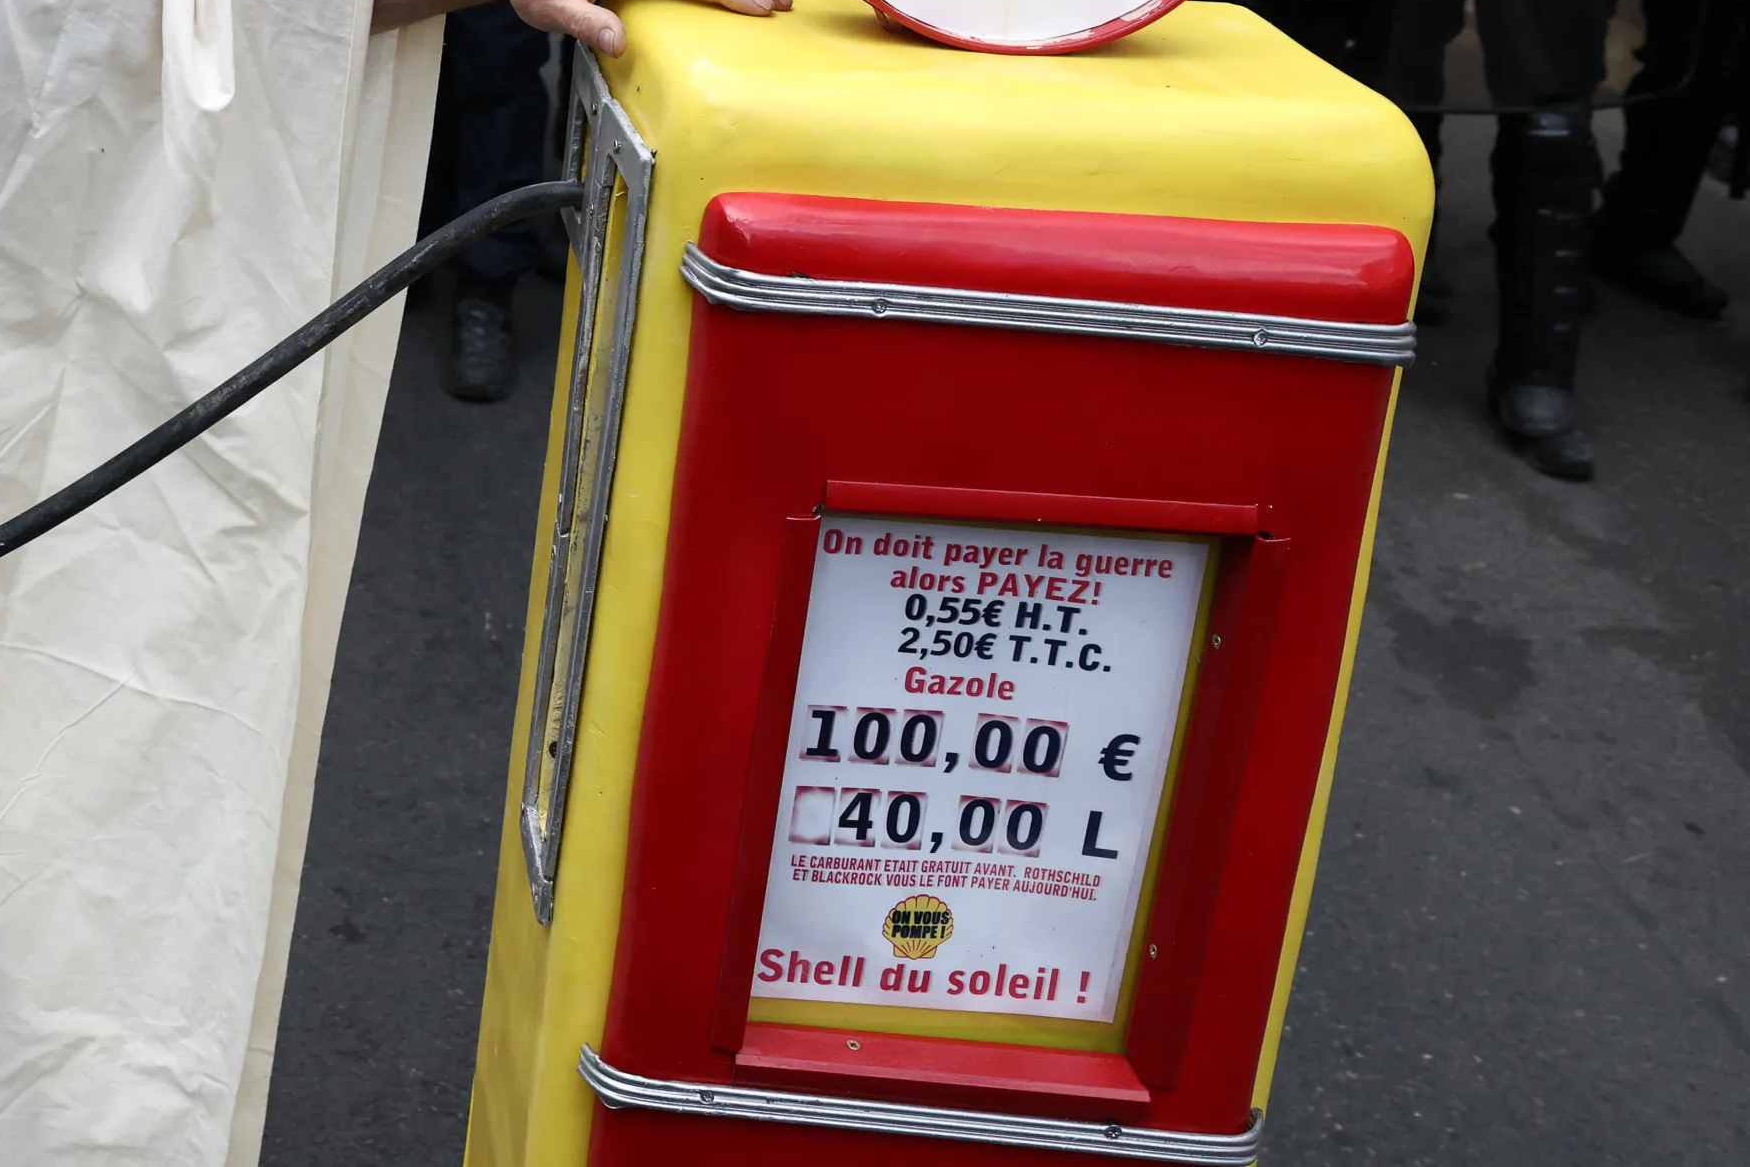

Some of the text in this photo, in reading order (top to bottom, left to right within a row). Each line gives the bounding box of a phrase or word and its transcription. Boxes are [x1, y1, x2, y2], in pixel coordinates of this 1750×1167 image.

[823, 529, 1174, 579] On doit payer la guerre
[890, 566, 1102, 605] alors PAYEZ!
[905, 594, 1088, 635] 0,55€ H.T.
[898, 627, 1111, 672] 2,50€ T.T.C.
[904, 666, 1015, 701] Gazole
[805, 710, 1140, 782] 100,00 €
[838, 792, 1119, 859] 40,00 L
[791, 855, 1101, 887] LE CARBURANT ETAIT GRATUIT AVANT. ROTHSCHILD
[792, 869, 1097, 901] ET BLACKROCK VOUS LE FONT PAYER AUJOURD'HUI.
[891, 924, 938, 939] POMPE
[892, 910, 950, 925] ON VOUS
[757, 948, 866, 987] Shell
[879, 963, 932, 993] du
[946, 964, 1060, 1001] soleil
